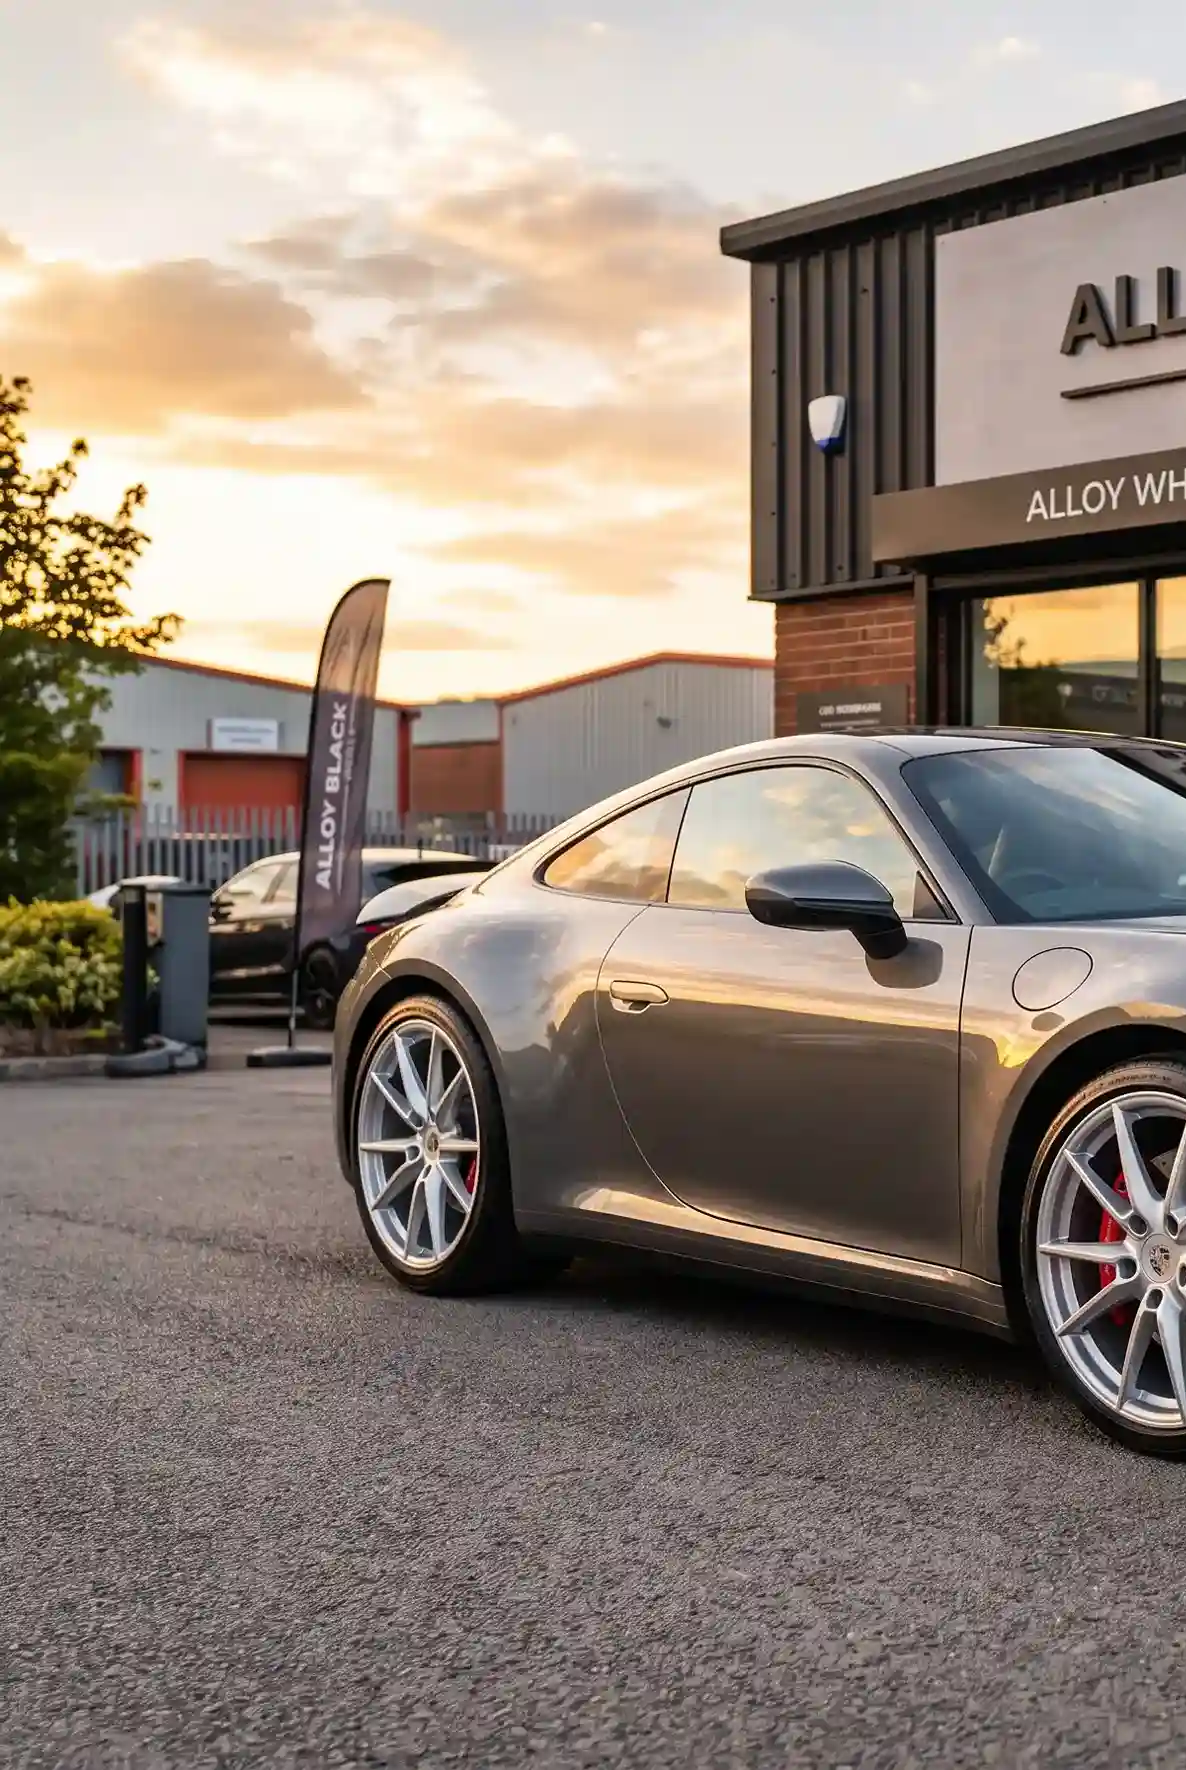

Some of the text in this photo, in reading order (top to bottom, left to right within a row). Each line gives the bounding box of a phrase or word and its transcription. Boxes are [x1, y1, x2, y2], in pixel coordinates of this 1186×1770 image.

[1026, 476, 1126, 523] ALLOY
[315, 701, 348, 890] ALLOY BLACK
